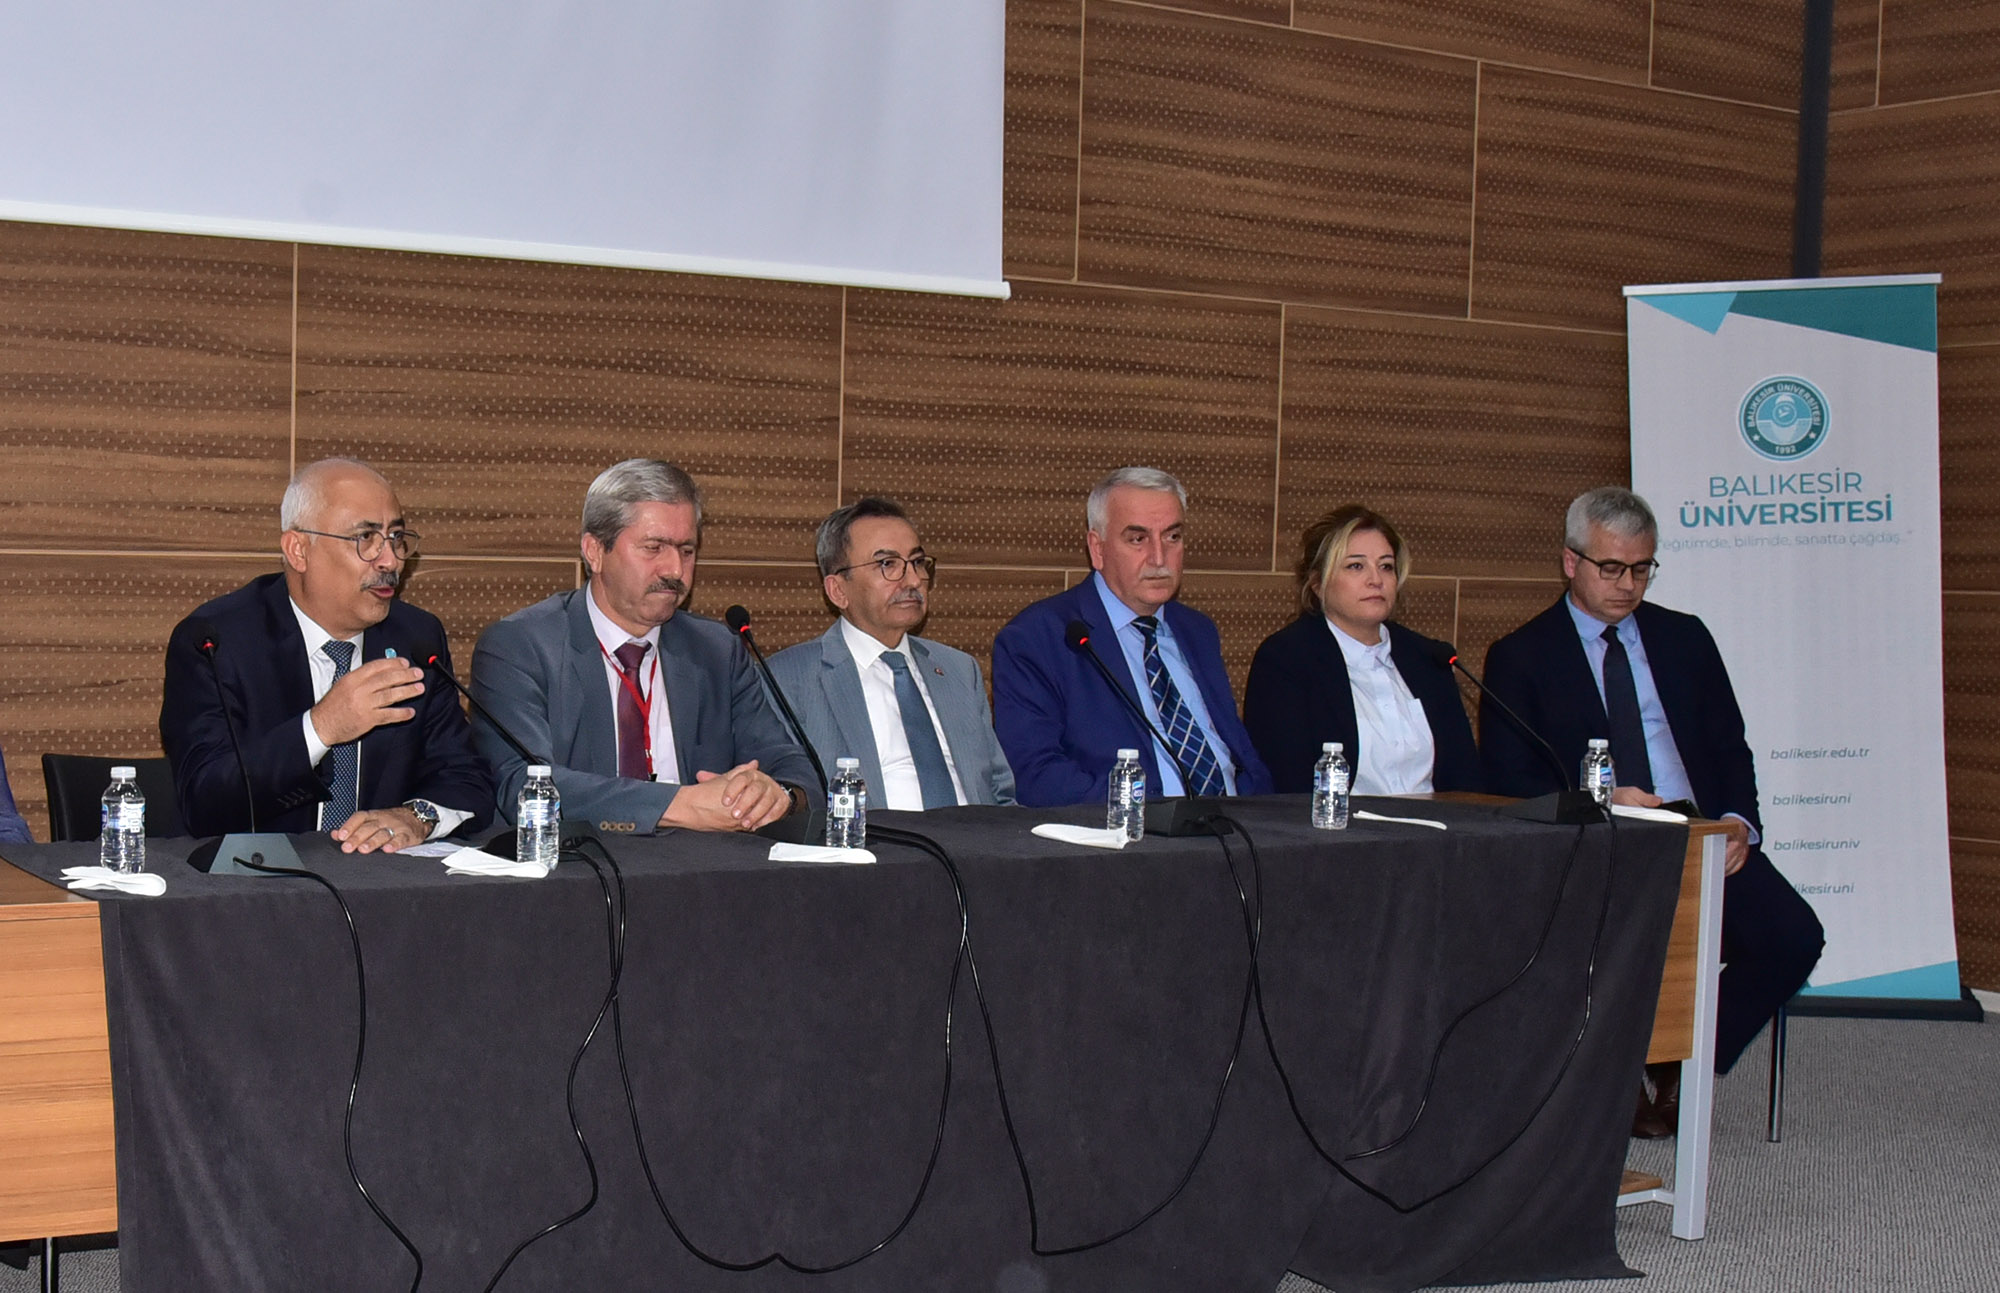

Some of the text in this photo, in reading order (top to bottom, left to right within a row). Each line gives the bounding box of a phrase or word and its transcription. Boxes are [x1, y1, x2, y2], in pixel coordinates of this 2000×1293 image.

[1747, 382, 1821, 428] BALIKESİR ÜNİVERSİTESİ
[1709, 467, 1863, 498] BALIKESİR
[1679, 493, 1892, 528] ÜNİVERSİTESİ
[1794, 533, 1846, 545] sanatta
[1770, 747, 1869, 760] balikesir.edu.tr
[1772, 793, 1852, 806] balikesiruni
[1773, 838, 1860, 851] balikesiruniv
[1794, 882, 1855, 895] likesiruni
